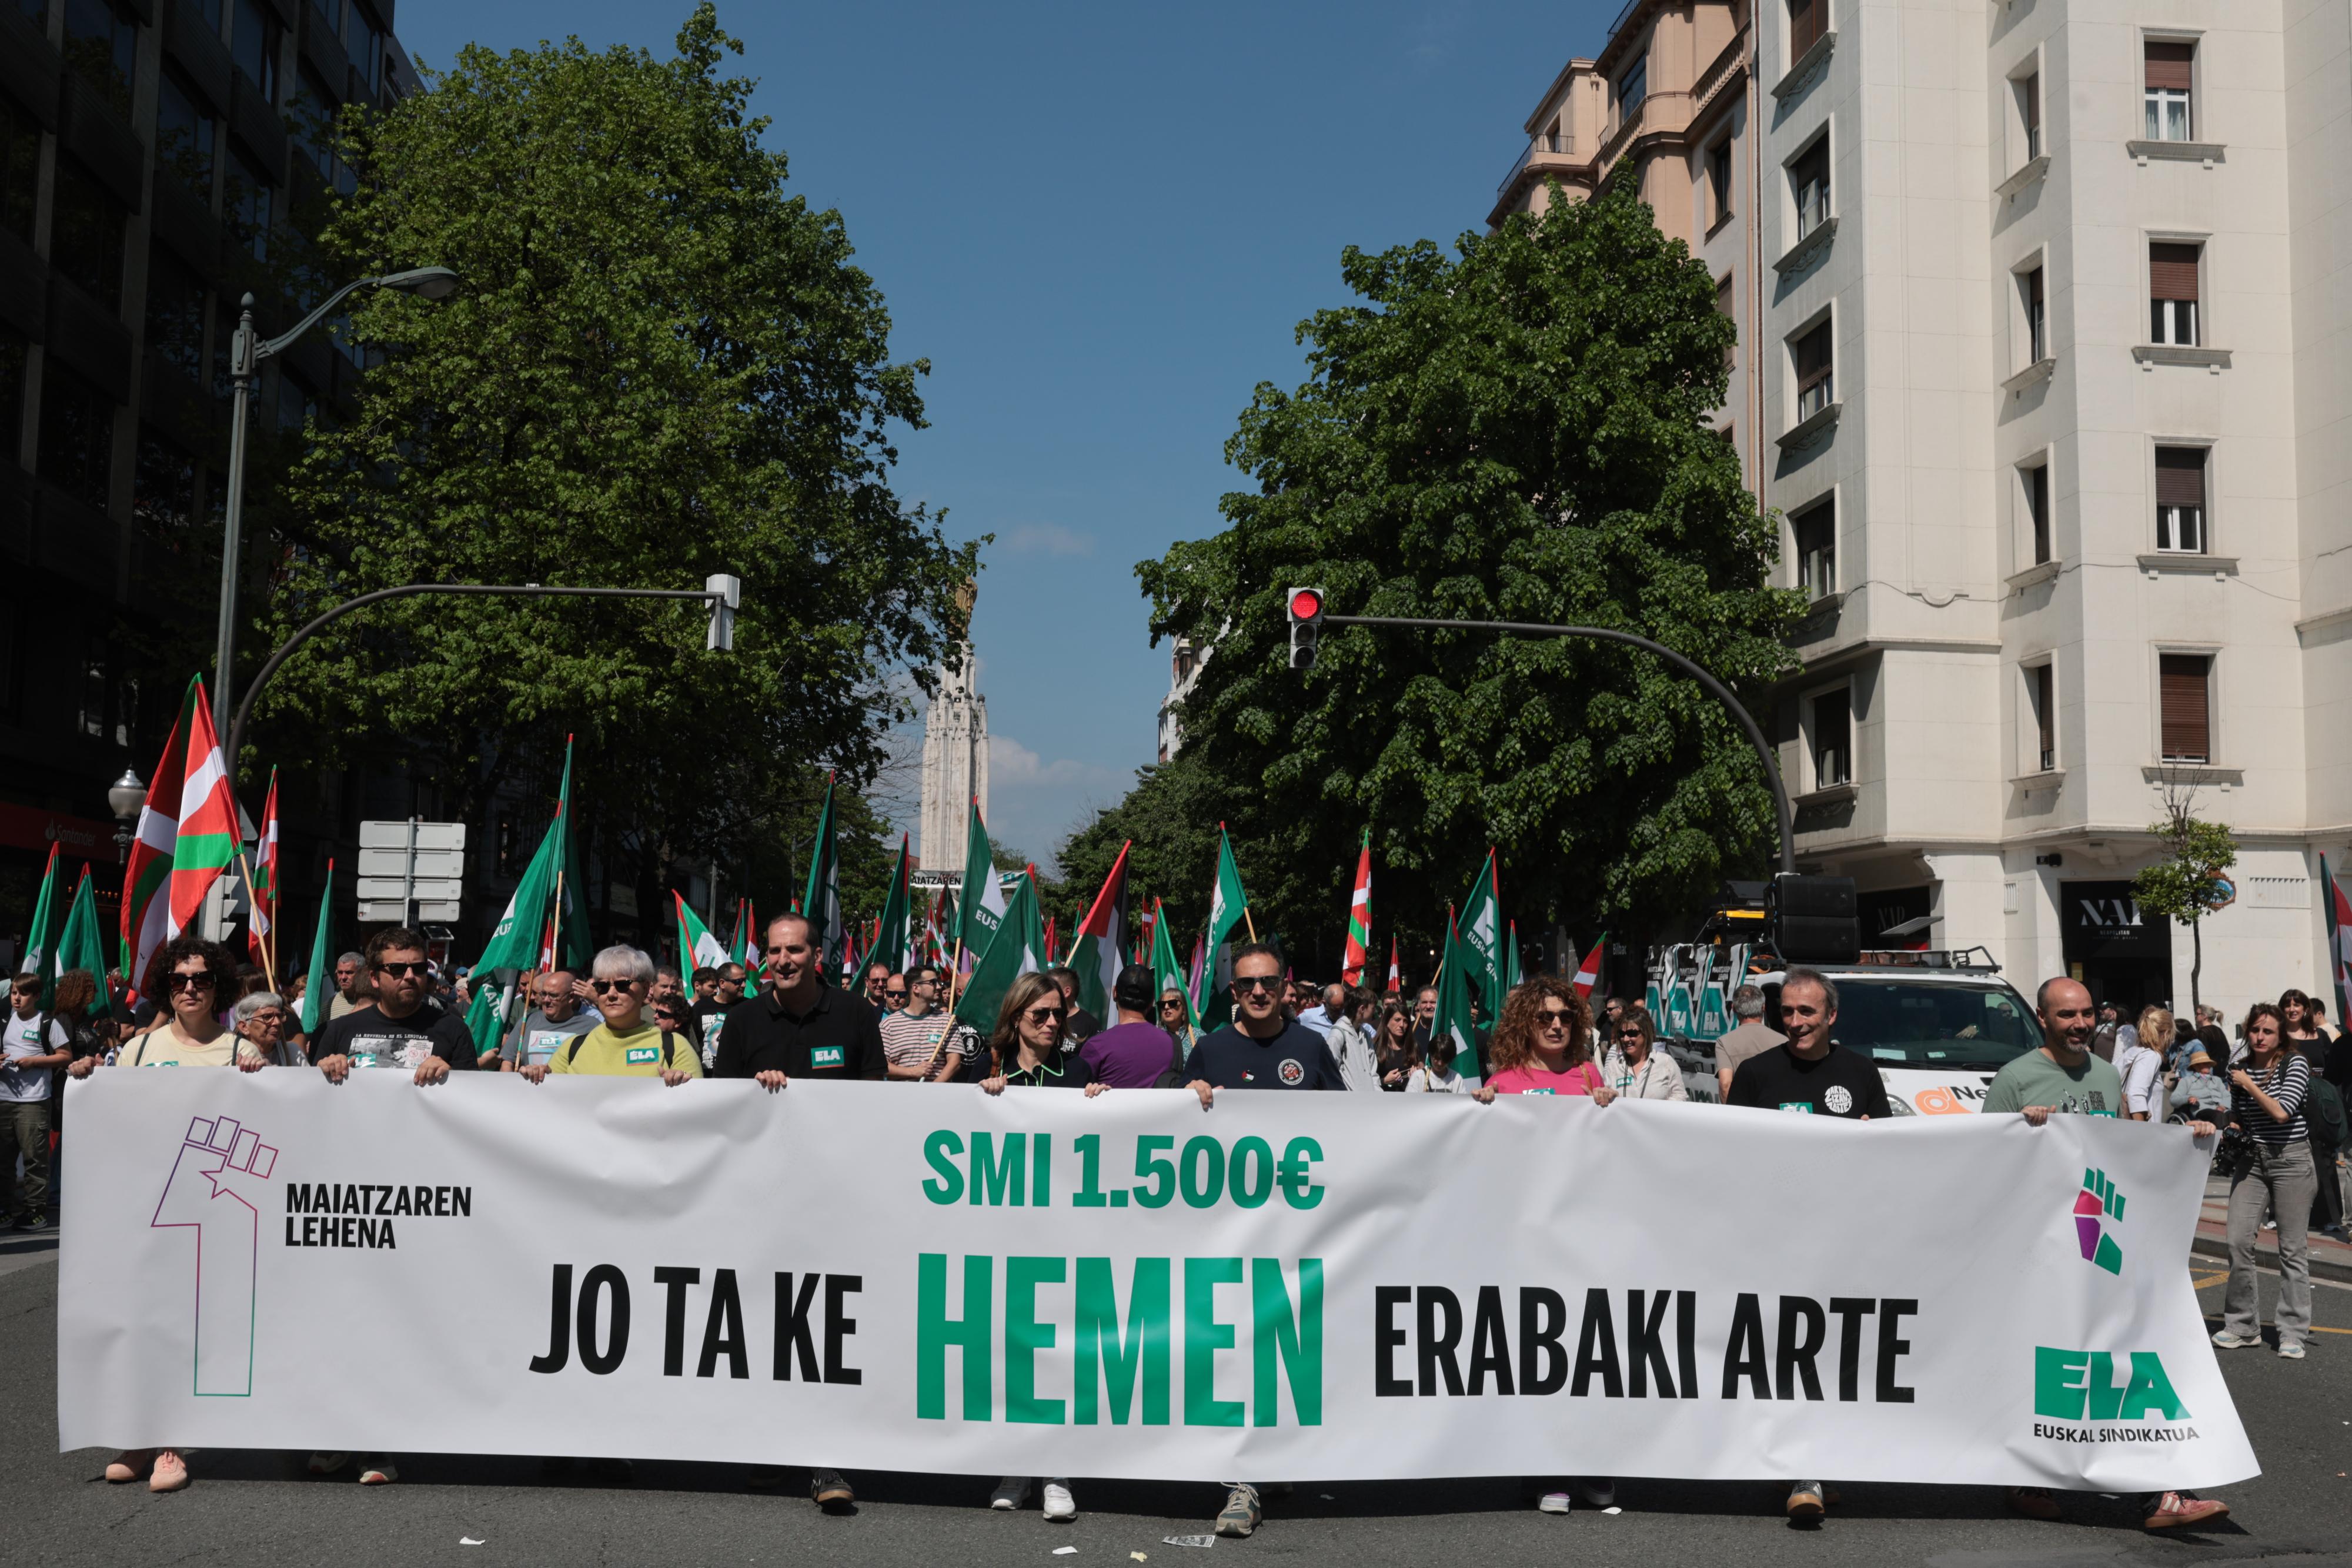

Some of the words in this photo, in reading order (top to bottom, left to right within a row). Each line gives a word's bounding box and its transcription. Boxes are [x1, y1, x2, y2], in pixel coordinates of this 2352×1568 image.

[57, 824, 95, 847] Santander
[910, 876, 961, 885] AIATZAREN
[975, 909, 998, 931] EUS
[1467, 931, 1486, 957] EUSK
[630, 1049, 655, 1061] ELA
[815, 1049, 840, 1062] ELA
[922, 1130, 1051, 1207] SMI
[1073, 1134, 1325, 1210] 1.500€
[287, 1183, 472, 1217] MAIATZAREN
[286, 1217, 396, 1249] LEHENA
[529, 1264, 630, 1375] JO
[654, 1266, 750, 1379] TA
[773, 1271, 863, 1385] KE
[917, 1253, 1324, 1427] HEMEN
[1375, 1286, 1699, 1399] ERABAKI
[1722, 1292, 1918, 1403] ARTE
[2034, 1346, 2193, 1421] ELA
[2034, 1423, 2095, 1443] EUSKAL
[2099, 1426, 2200, 1443] SINDIKATUA
